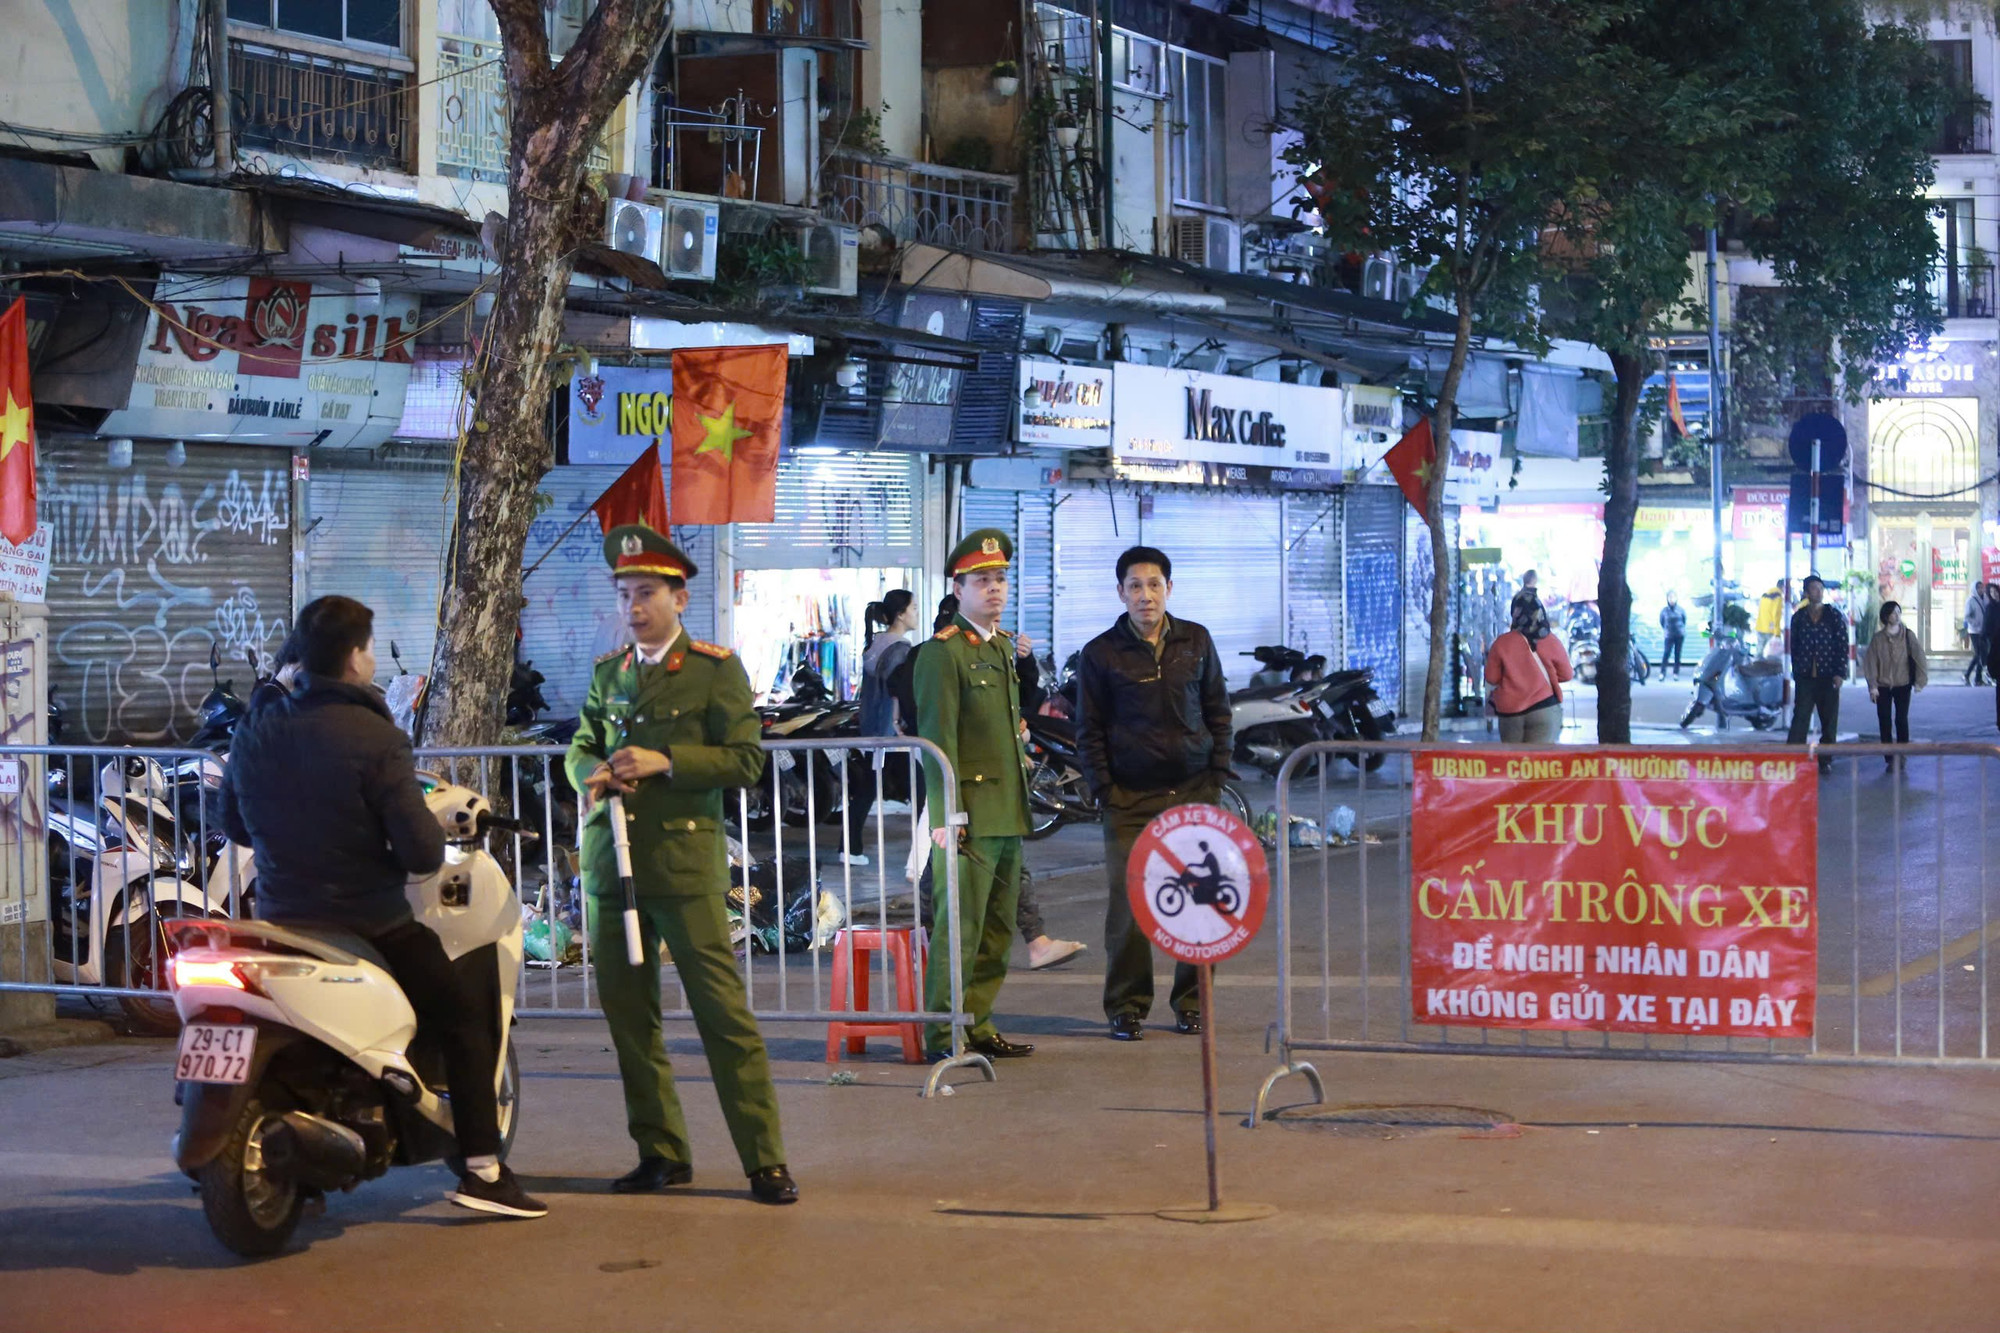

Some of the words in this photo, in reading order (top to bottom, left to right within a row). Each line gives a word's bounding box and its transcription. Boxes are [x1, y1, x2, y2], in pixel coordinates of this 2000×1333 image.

[149, 302, 246, 362] Nga
[311, 313, 414, 364] silk
[1185, 386, 1237, 443] Max
[1239, 410, 1286, 448] Coffee
[27, 550, 45, 561] GAI
[1432, 758, 1486, 778] UBND
[1507, 757, 1563, 779] CÔNG
[1570, 759, 1599, 778] AN
[1605, 755, 1689, 780] PHƯỜNG
[1697, 757, 1754, 780] HÀNG
[1761, 761, 1796, 780] GAI
[1183, 811, 1203, 823] XE
[1493, 804, 1607, 845] KHU
[1620, 800, 1728, 860] VỰC
[1418, 860, 1528, 921] CẤM
[1543, 868, 1726, 928] TRÔNG
[1738, 886, 1809, 929] XE
[1154, 928, 1172, 948] NO
[1174, 926, 1250, 959] MOTORBIKE
[1453, 935, 1493, 971] ĐỀ
[1504, 942, 1585, 979] NGHỊ
[1597, 942, 1688, 977] NHÂN
[1699, 945, 1770, 979] DÂN
[1427, 985, 1538, 1019] KHÔNG
[1549, 983, 1605, 1021] GỬI
[1617, 994, 1658, 1023] XE
[1666, 995, 1719, 1030] TẠI
[1729, 993, 1798, 1027] ĐÂY
[190, 1027, 244, 1053] 29-C1
[180, 1053, 248, 1080] 970.72
